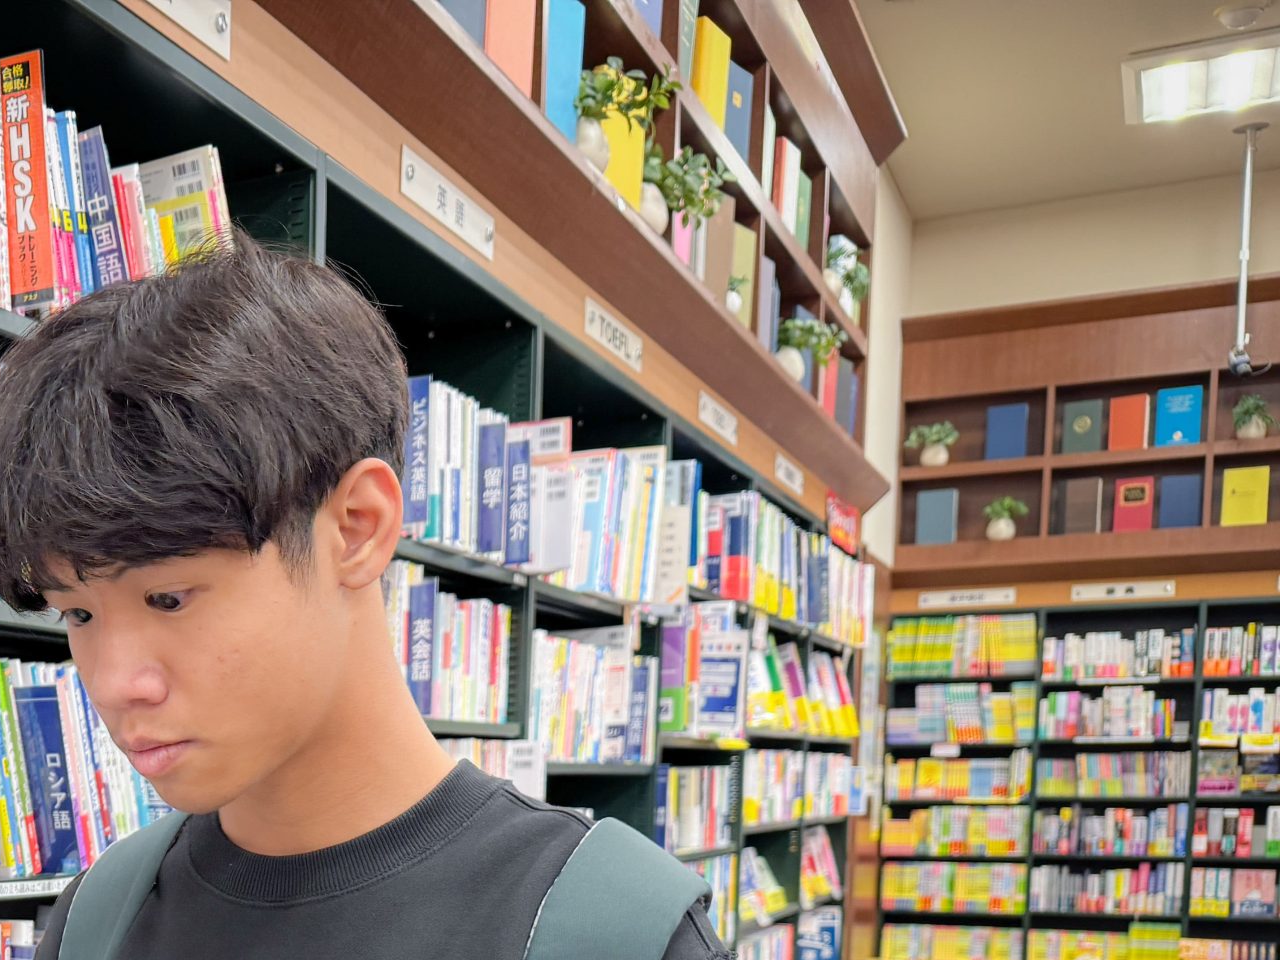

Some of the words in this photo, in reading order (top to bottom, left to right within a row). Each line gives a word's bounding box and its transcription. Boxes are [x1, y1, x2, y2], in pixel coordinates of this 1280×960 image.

[1, 64, 24, 79] 合格
[89, 193, 120, 283] 中国語
[598, 316, 632, 360] TOEFL
[410, 399, 428, 501] ビジネス英語
[483, 467, 502, 509] 留学
[509, 463, 528, 541] 日本紹介
[412, 618, 432, 681] 英会話
[46, 752, 71, 831] ロシア語
